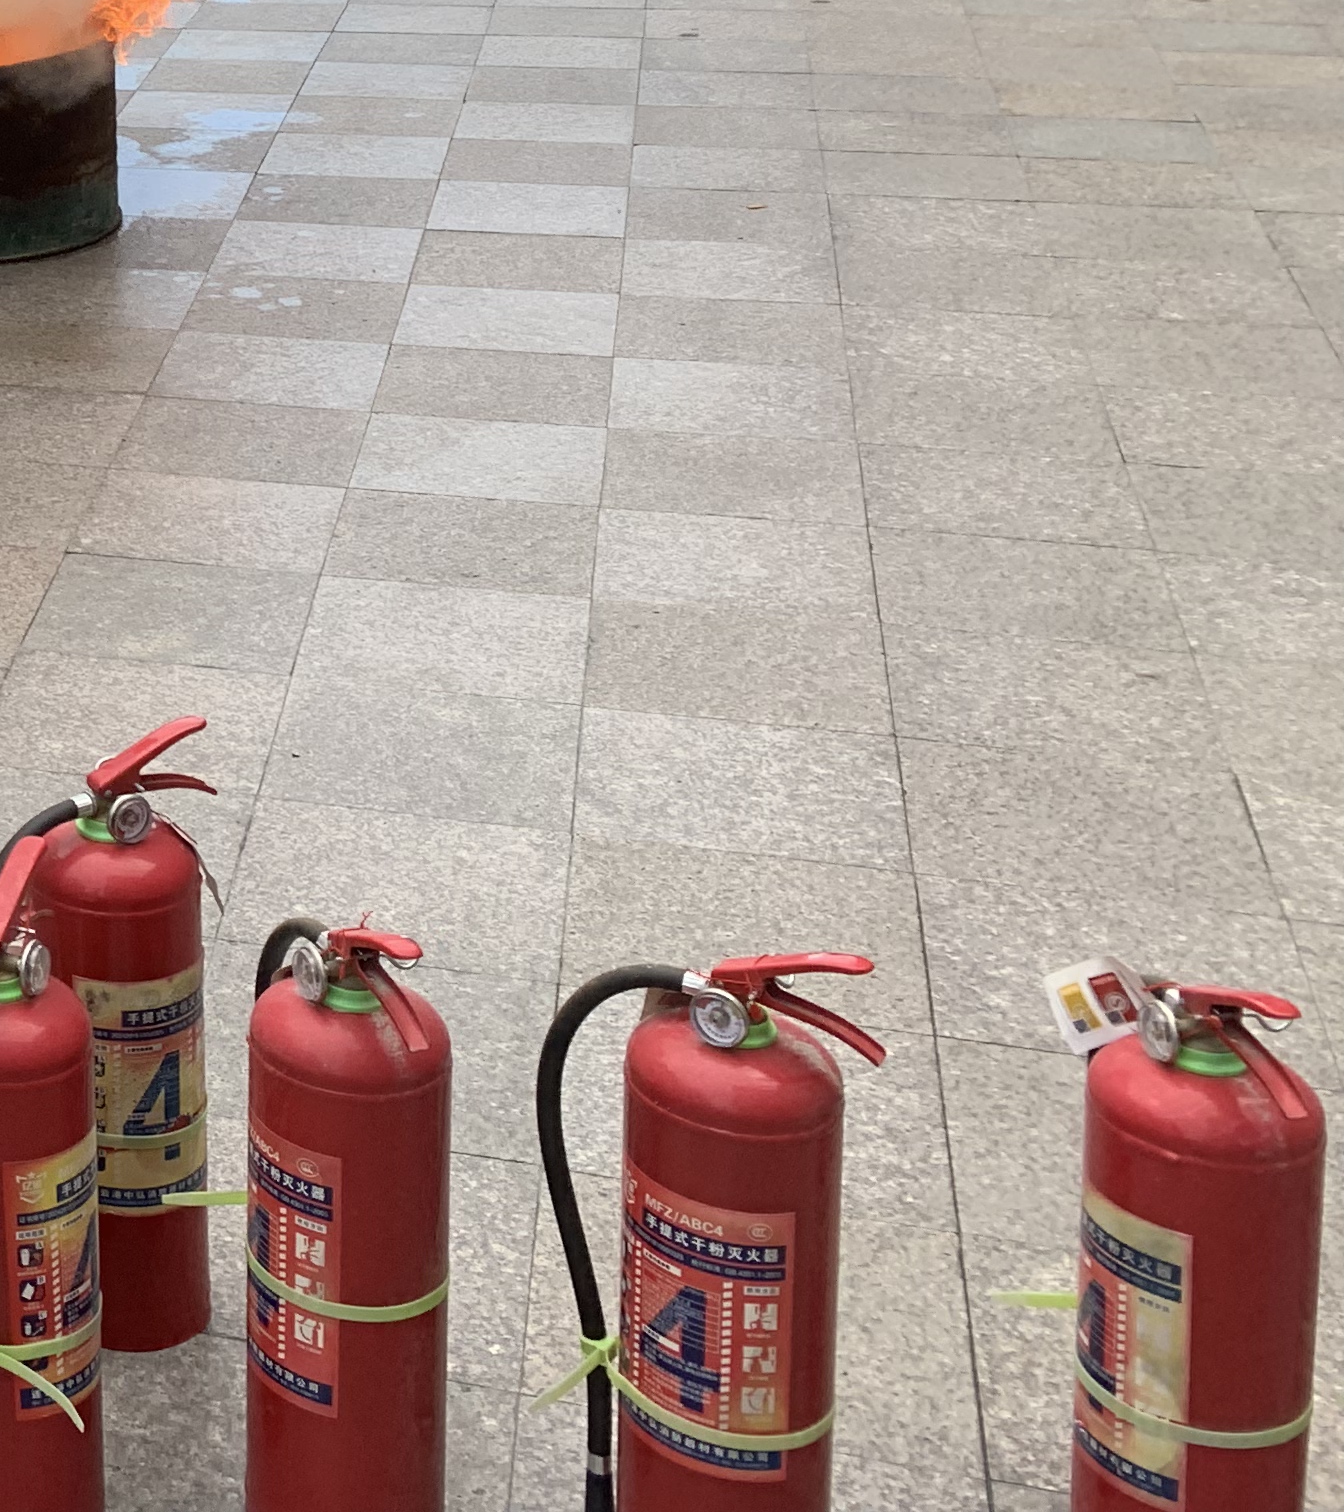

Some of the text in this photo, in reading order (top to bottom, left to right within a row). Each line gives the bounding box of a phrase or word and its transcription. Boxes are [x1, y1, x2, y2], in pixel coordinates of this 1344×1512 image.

[645, 1192, 724, 1237] MFZ/ABC4
[645, 1212, 779, 1263] 手提式干粉灭火器
[641, 1285, 721, 1413] 4
